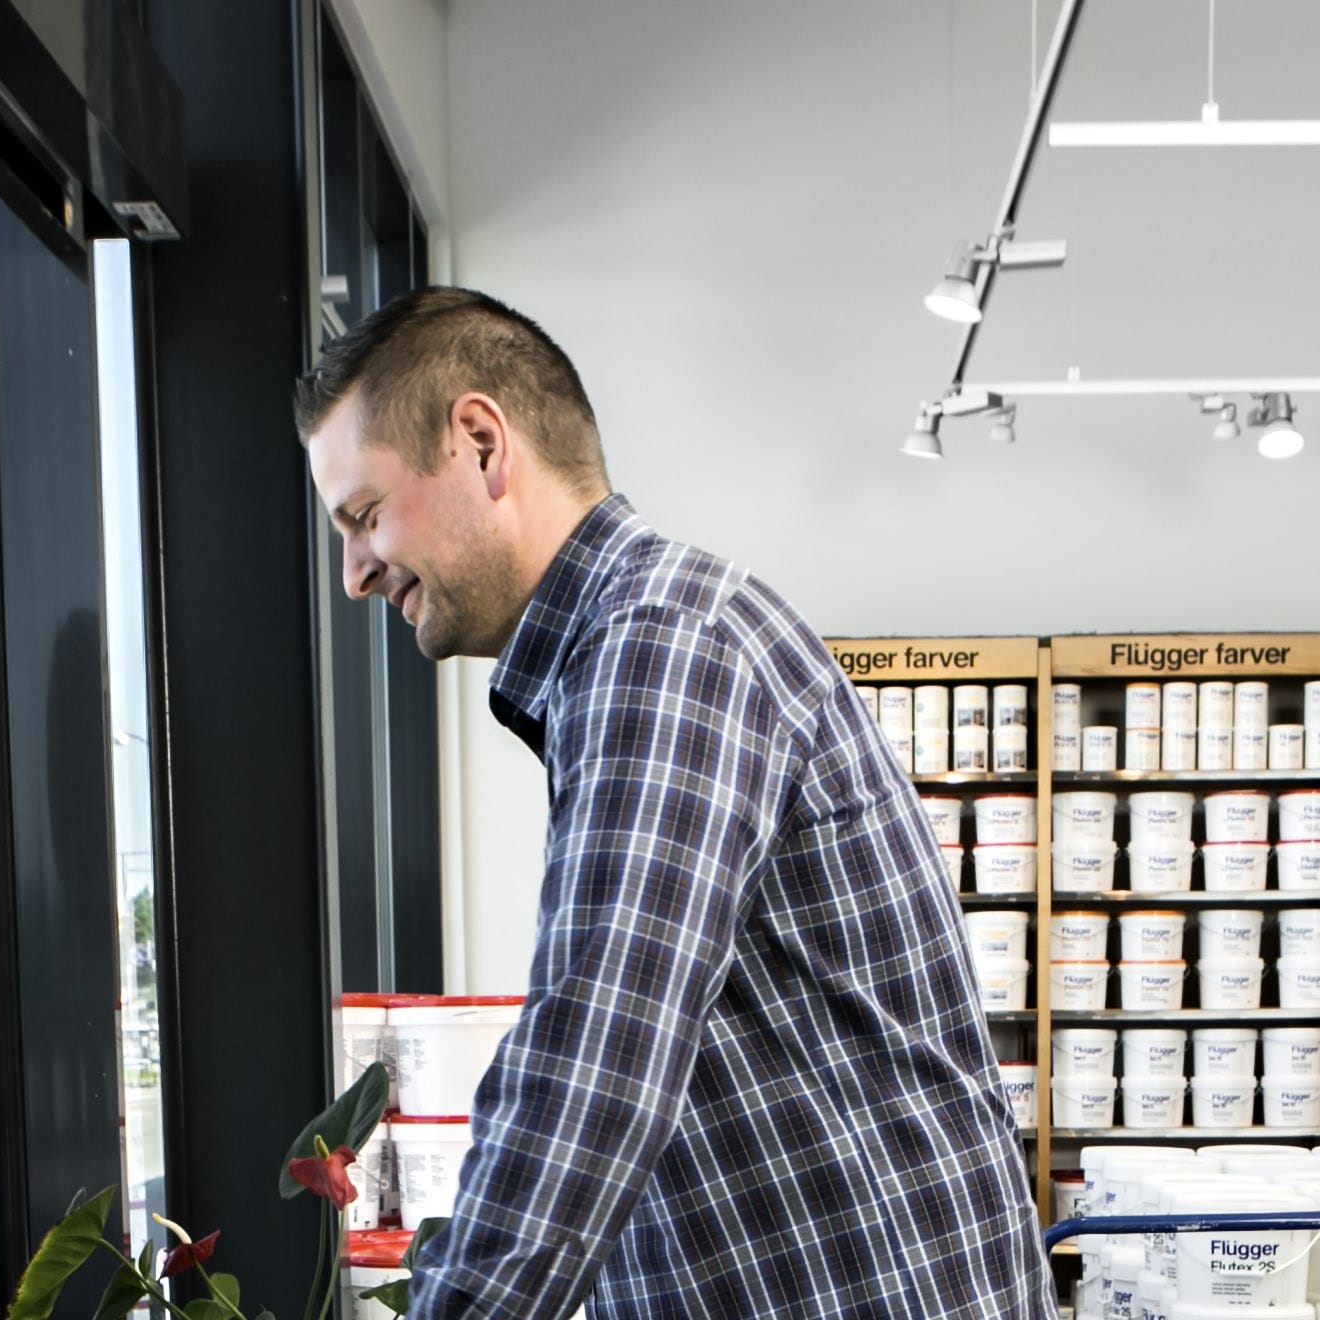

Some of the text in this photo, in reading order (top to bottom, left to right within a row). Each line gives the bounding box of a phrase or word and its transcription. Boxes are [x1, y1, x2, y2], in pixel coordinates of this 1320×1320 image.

[833, 647, 979, 674] gger farver
[1110, 643, 1291, 670] Flügger farver
[1211, 1240, 1280, 1260] Flügger
